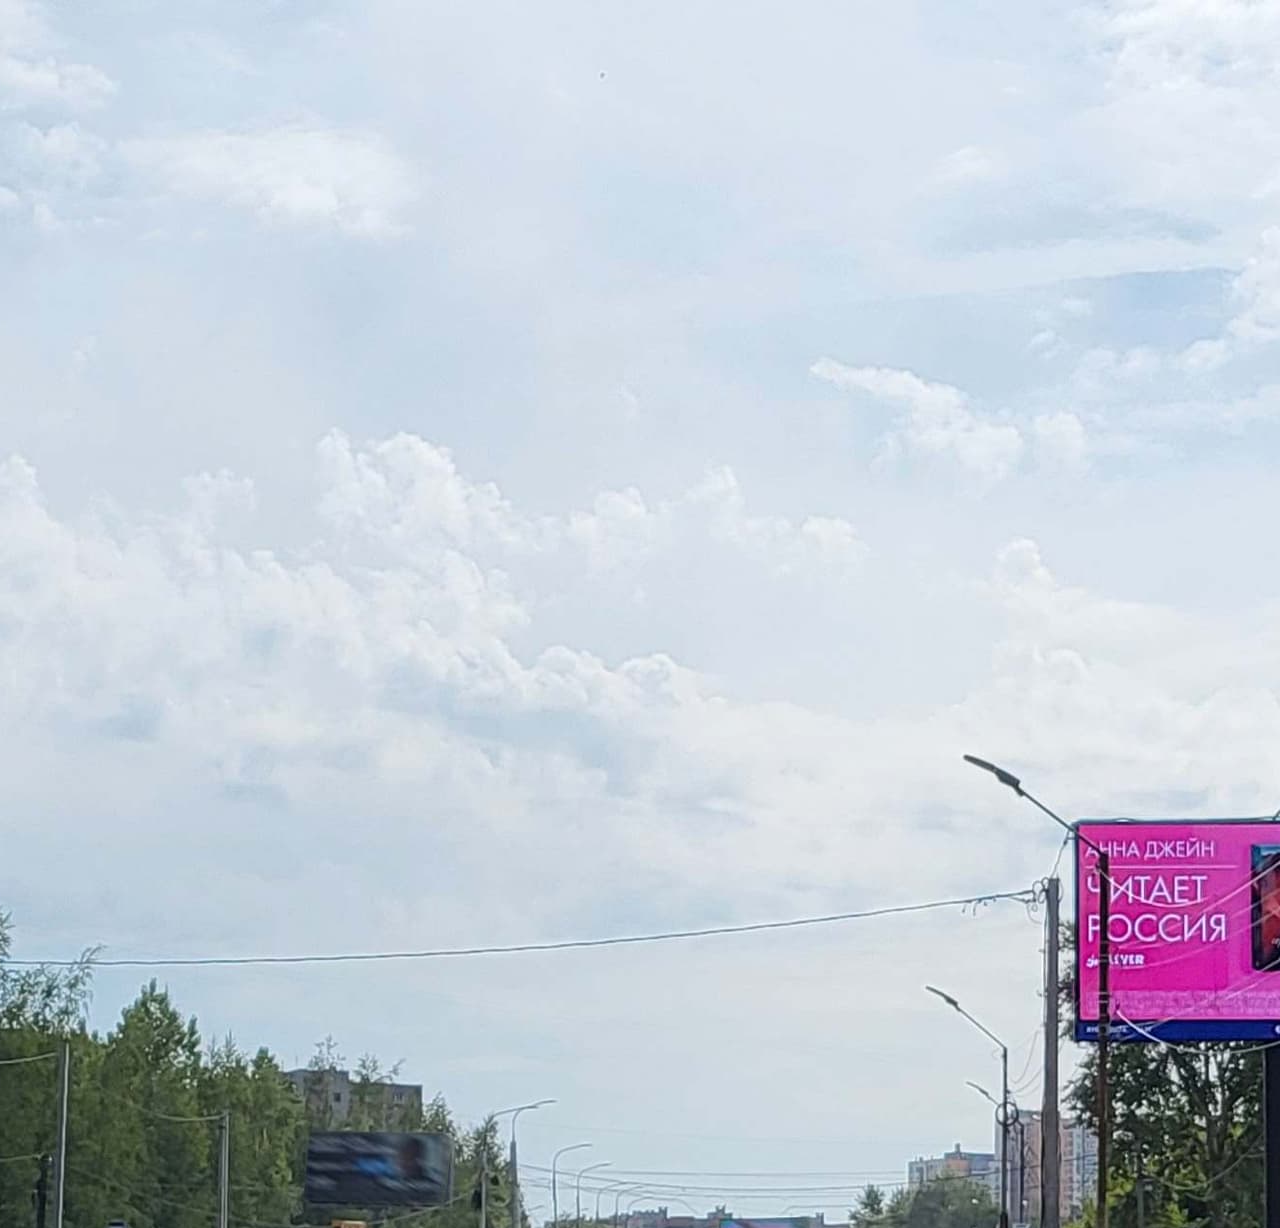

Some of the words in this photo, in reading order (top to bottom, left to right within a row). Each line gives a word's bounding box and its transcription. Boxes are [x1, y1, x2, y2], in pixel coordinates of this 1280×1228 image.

[1085, 840, 1140, 858] АННА
[1144, 837, 1215, 861] ДЖЕЙН
[1087, 913, 1227, 943] РОССИЯ
